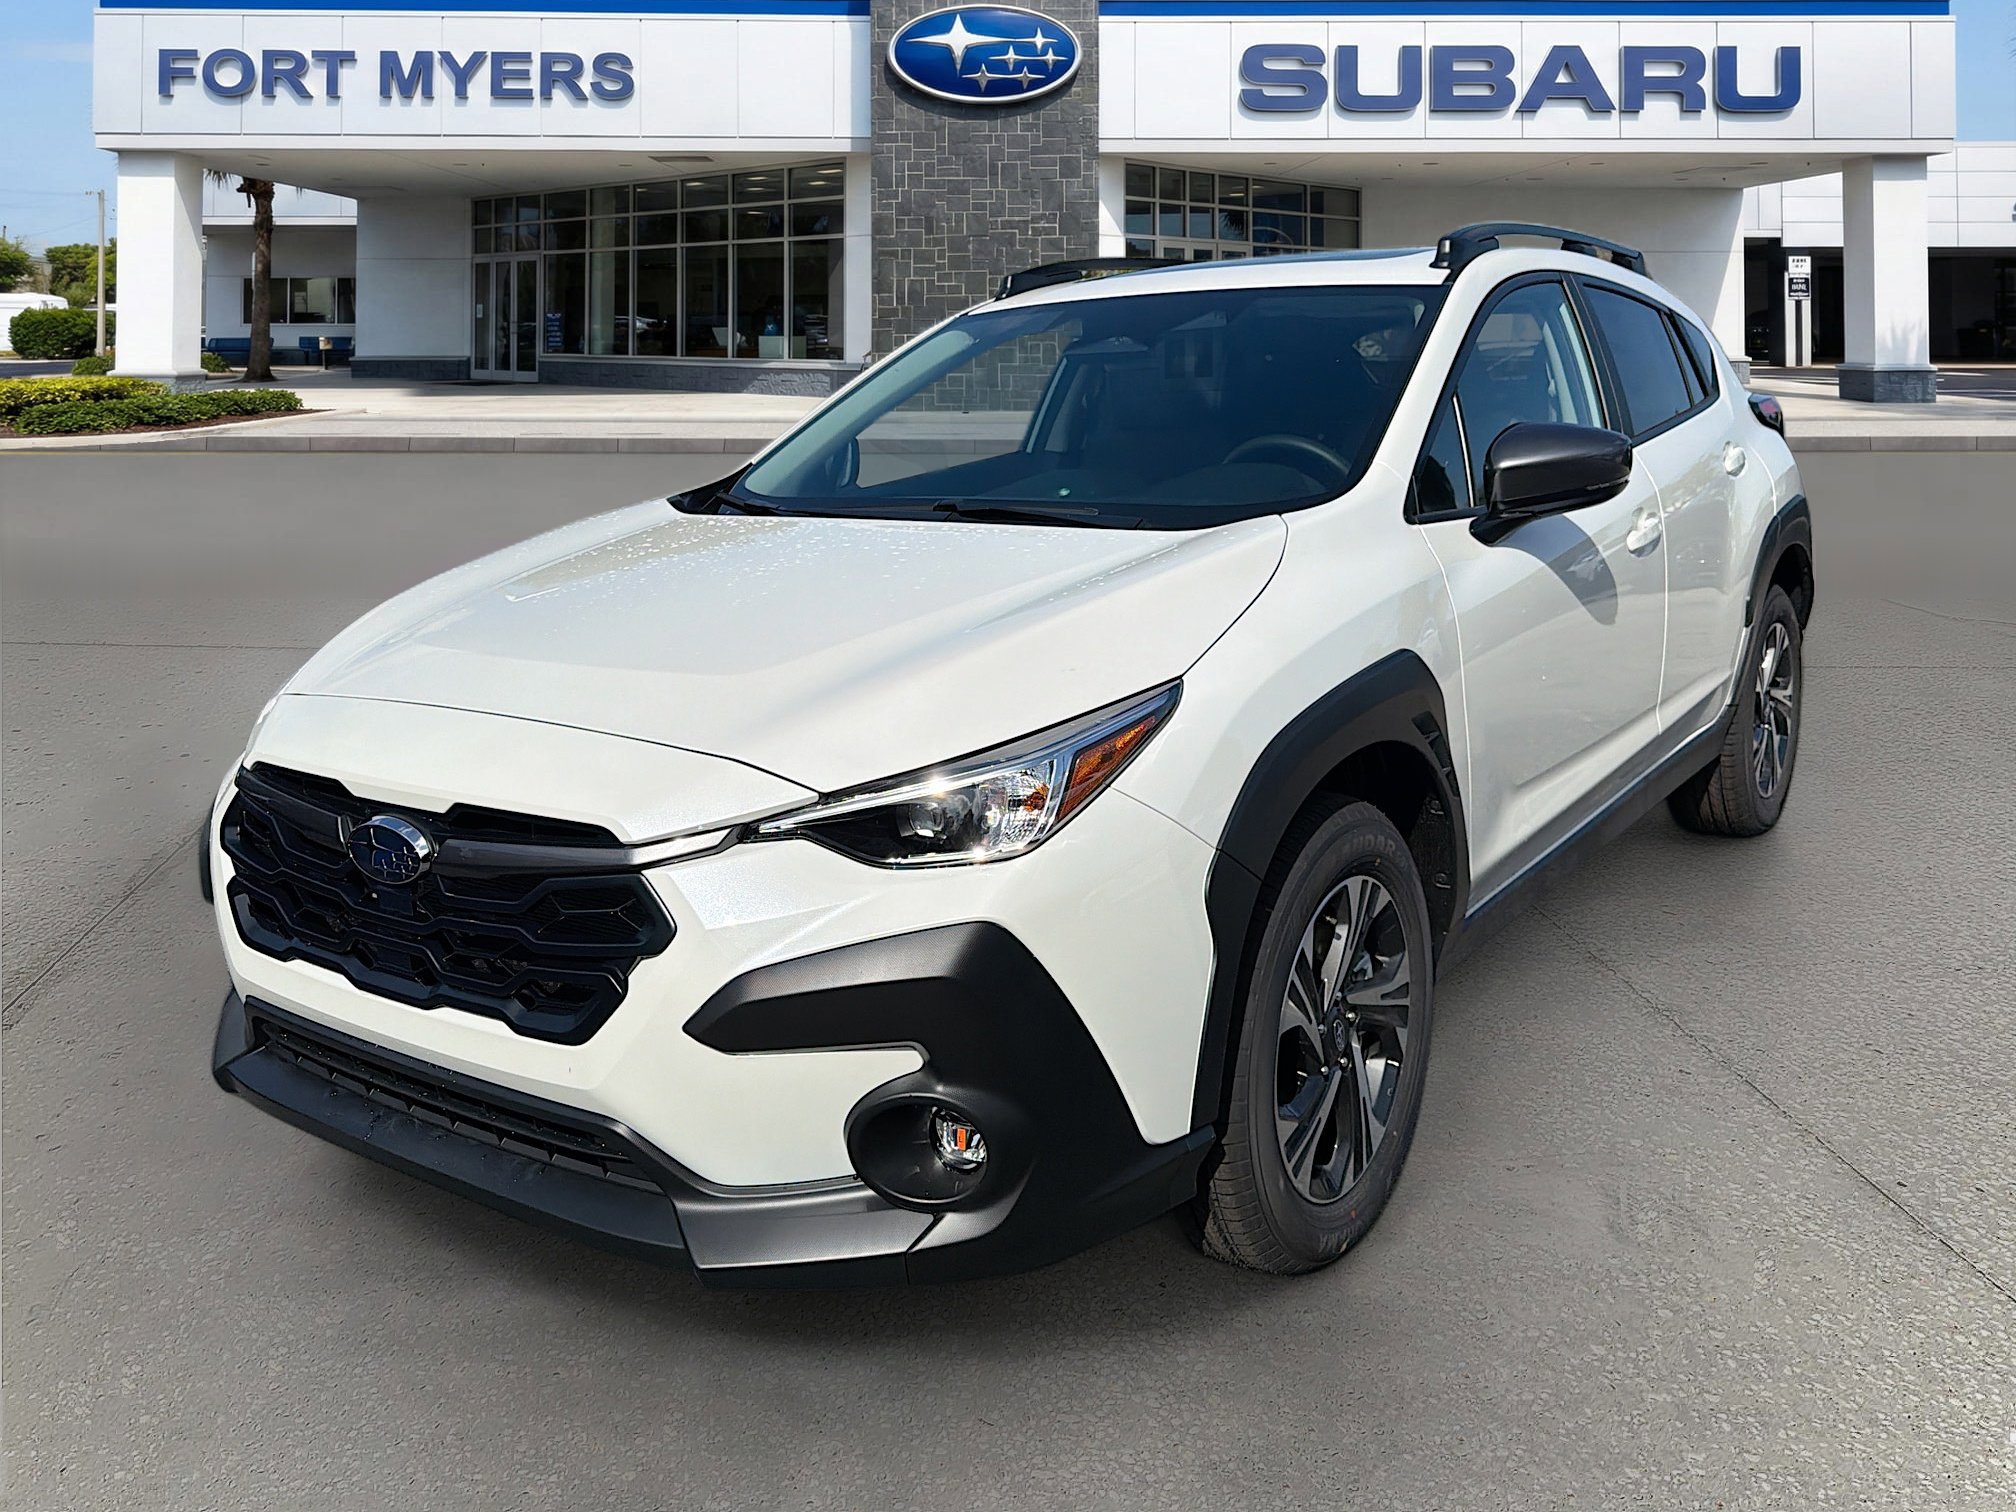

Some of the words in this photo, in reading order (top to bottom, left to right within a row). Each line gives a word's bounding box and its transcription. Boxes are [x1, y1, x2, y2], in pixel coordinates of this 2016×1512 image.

[158, 48, 357, 98] FORT
[379, 50, 635, 101] MYERS
[1239, 44, 1801, 113] SUBARU
